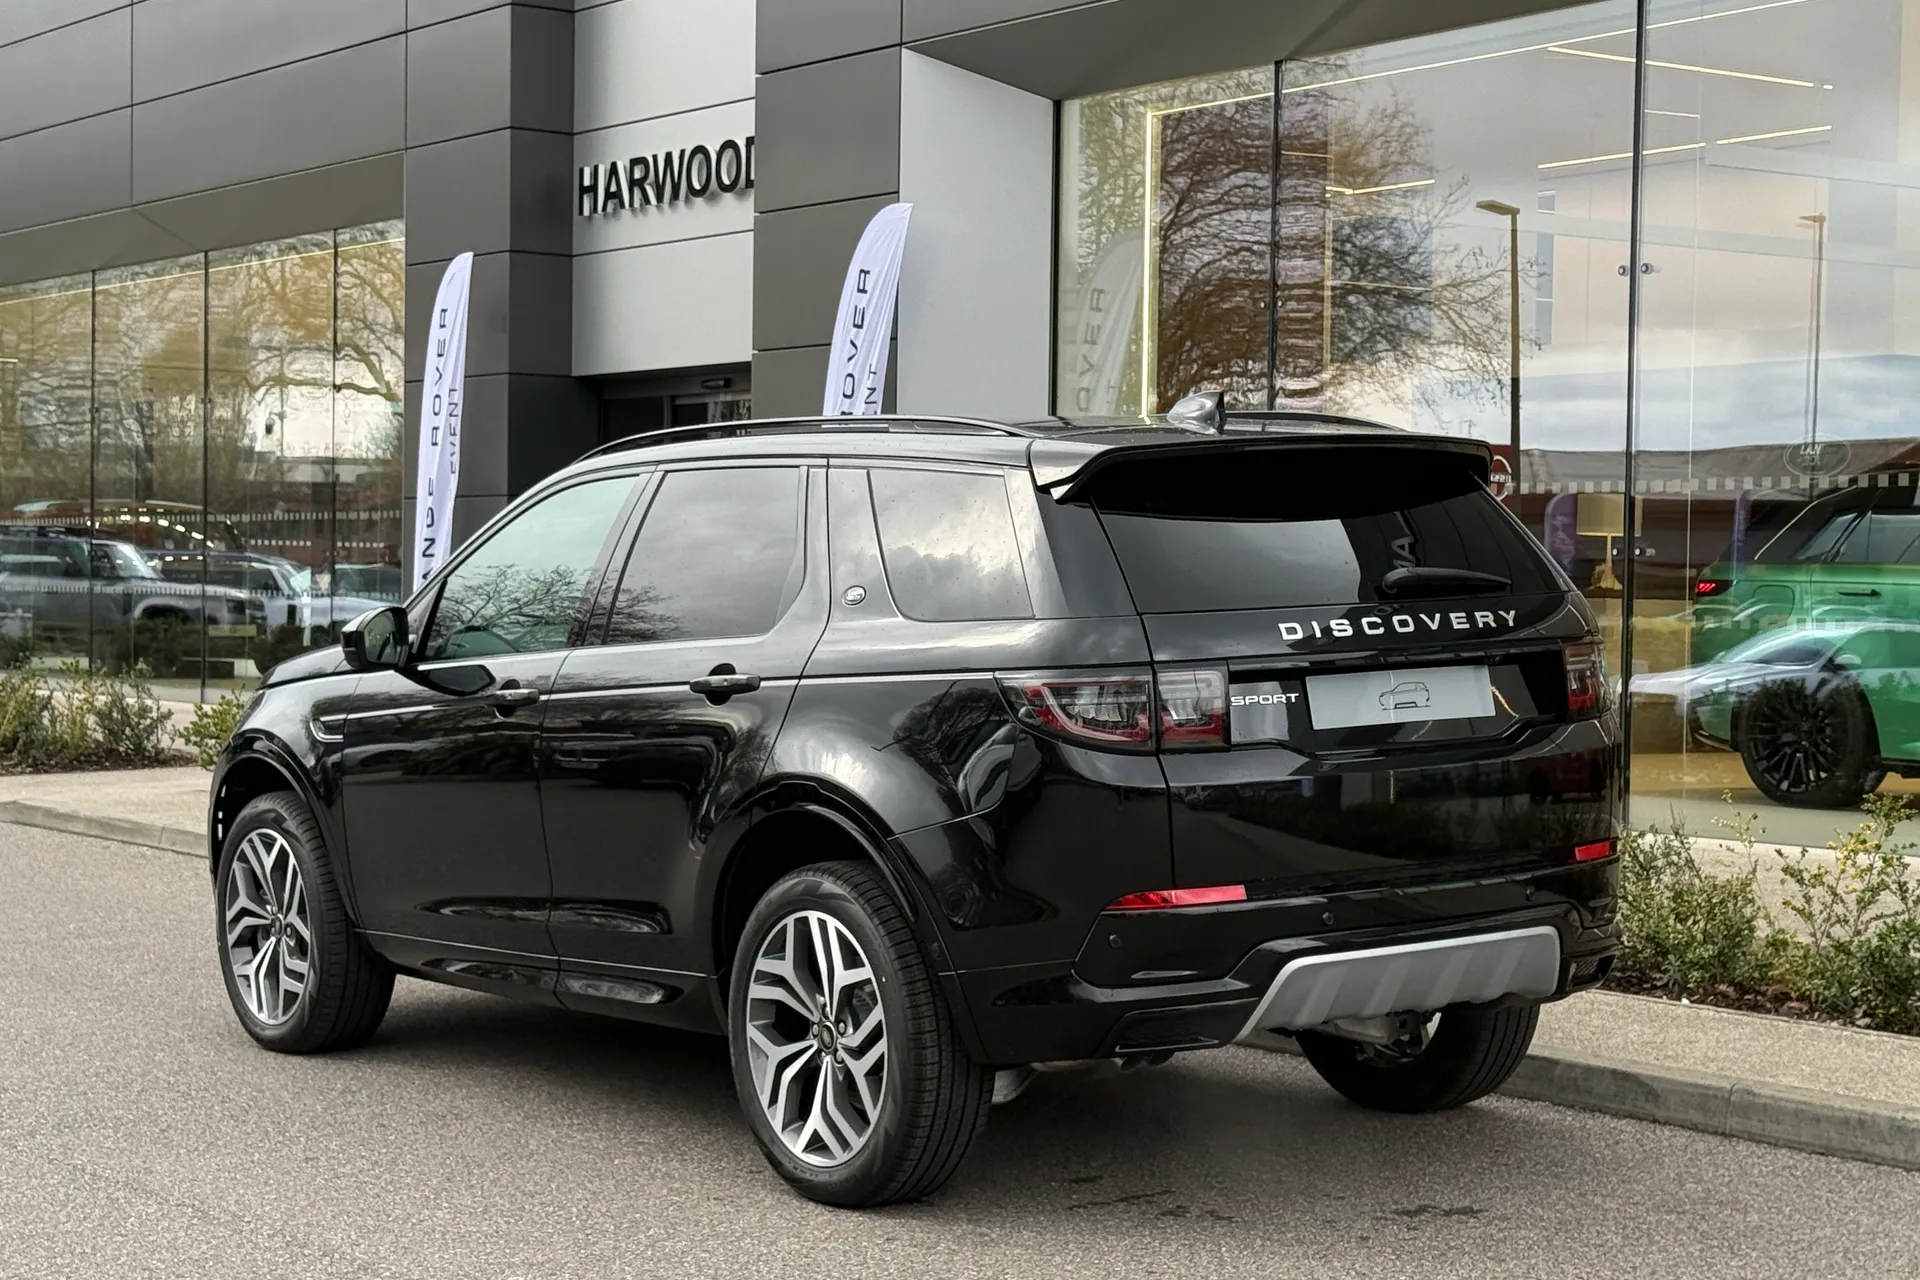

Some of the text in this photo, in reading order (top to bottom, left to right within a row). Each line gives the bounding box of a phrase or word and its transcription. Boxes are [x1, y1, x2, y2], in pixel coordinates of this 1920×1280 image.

[840, 268, 871, 415] OVER
[431, 308, 448, 447] ROVER
[862, 364, 877, 415] NT
[1277, 610, 1517, 641] DISCOVERY
[1230, 693, 1300, 706] SPORT
